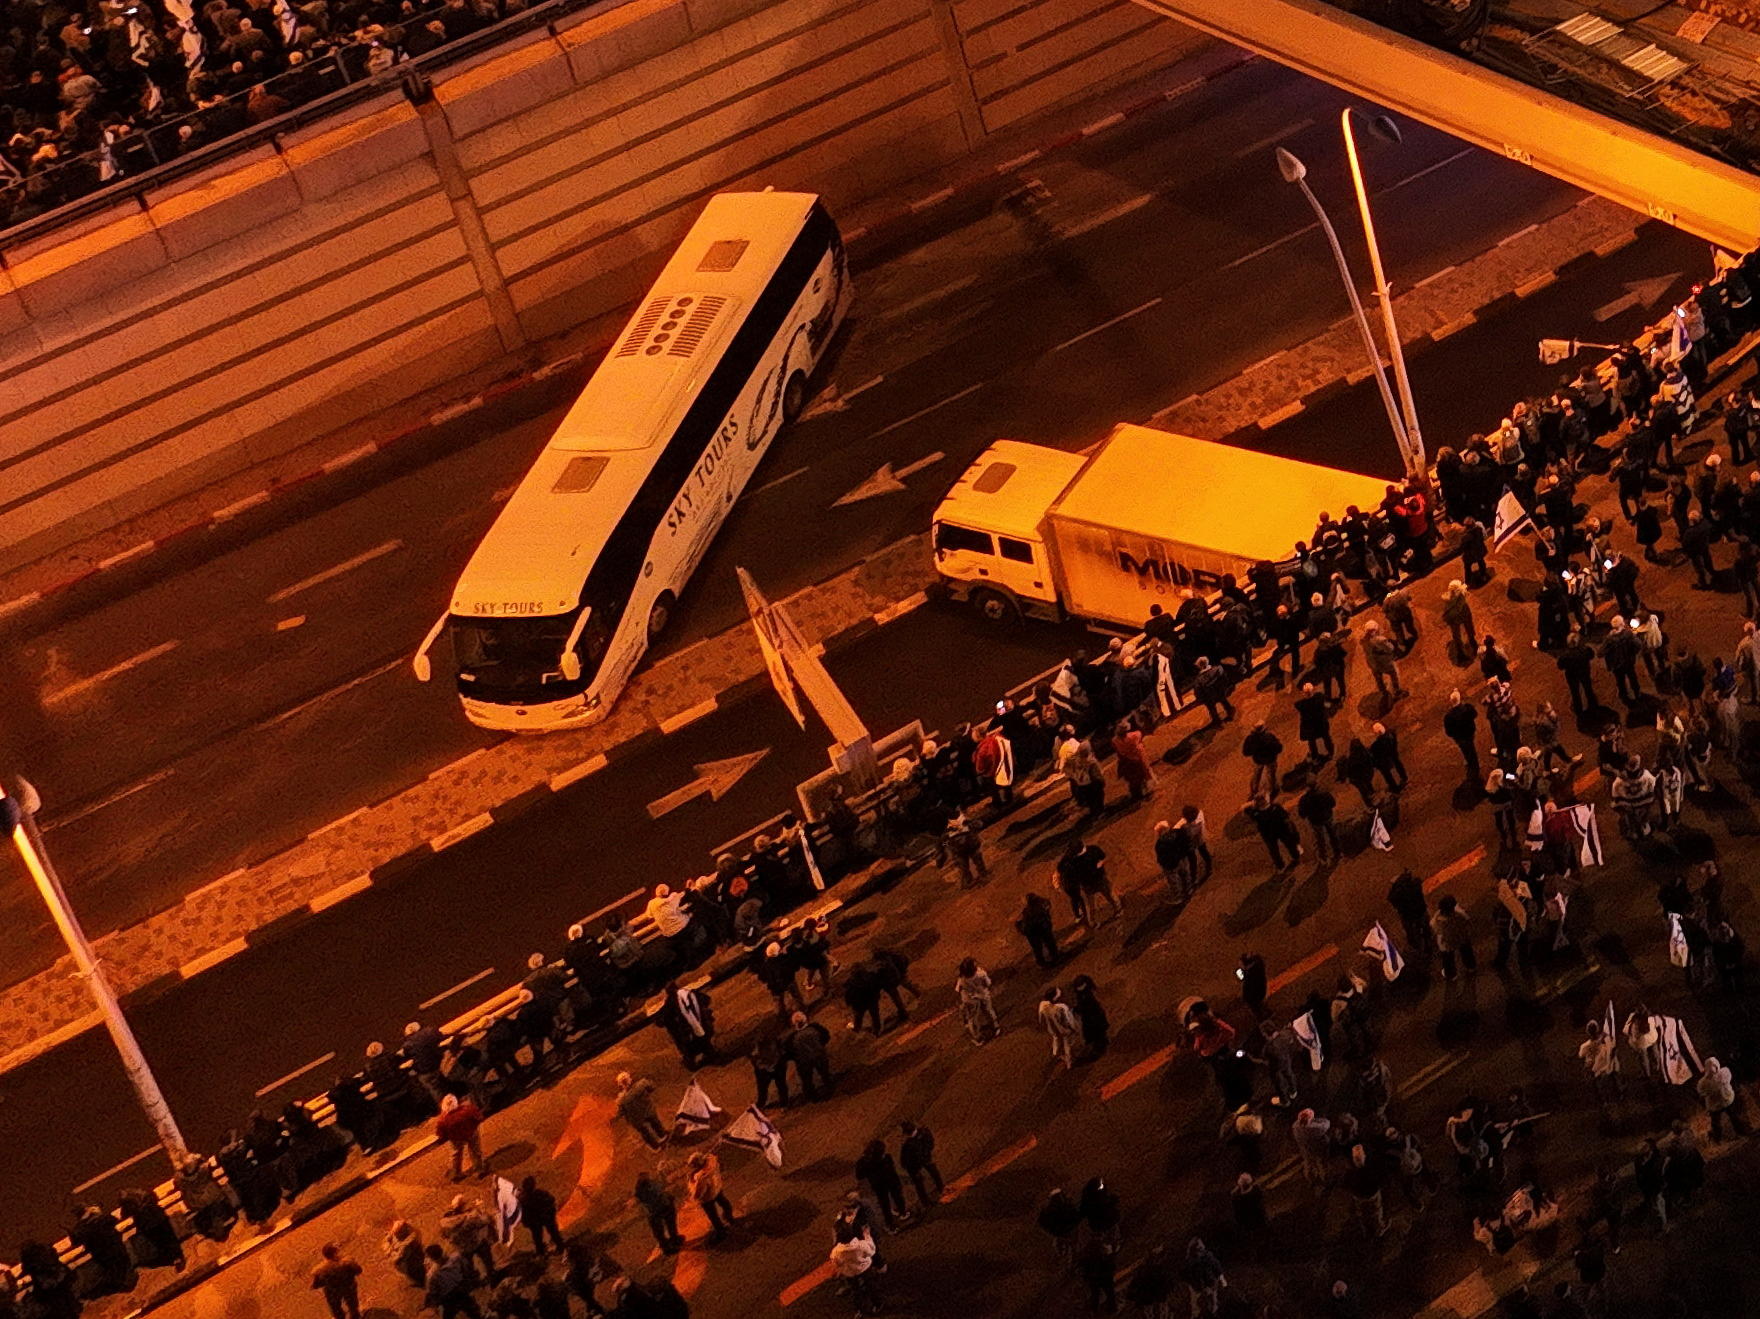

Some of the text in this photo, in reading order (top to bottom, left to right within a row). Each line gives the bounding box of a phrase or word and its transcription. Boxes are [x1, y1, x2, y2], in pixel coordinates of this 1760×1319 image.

[667, 485, 692, 537] SKY
[695, 413, 738, 488] TOURS
[473, 601, 544, 614] SKY TOURS
